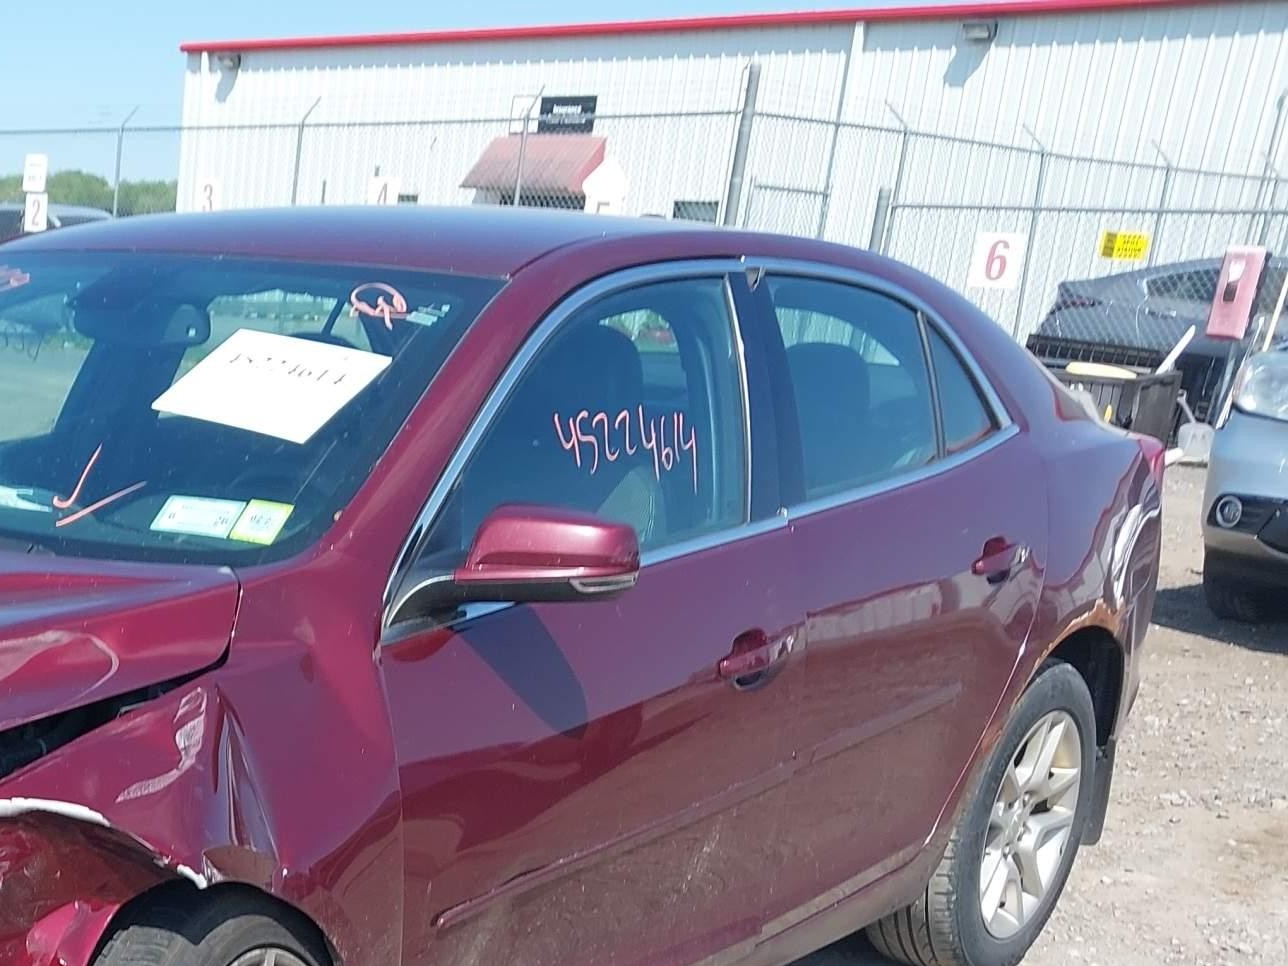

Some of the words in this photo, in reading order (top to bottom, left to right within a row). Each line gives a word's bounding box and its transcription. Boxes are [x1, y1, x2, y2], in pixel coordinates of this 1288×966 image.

[31, 198, 41, 226] 2
[202, 183, 213, 212] 3
[985, 239, 1010, 281] 6
[553, 403, 698, 496] 45224614
